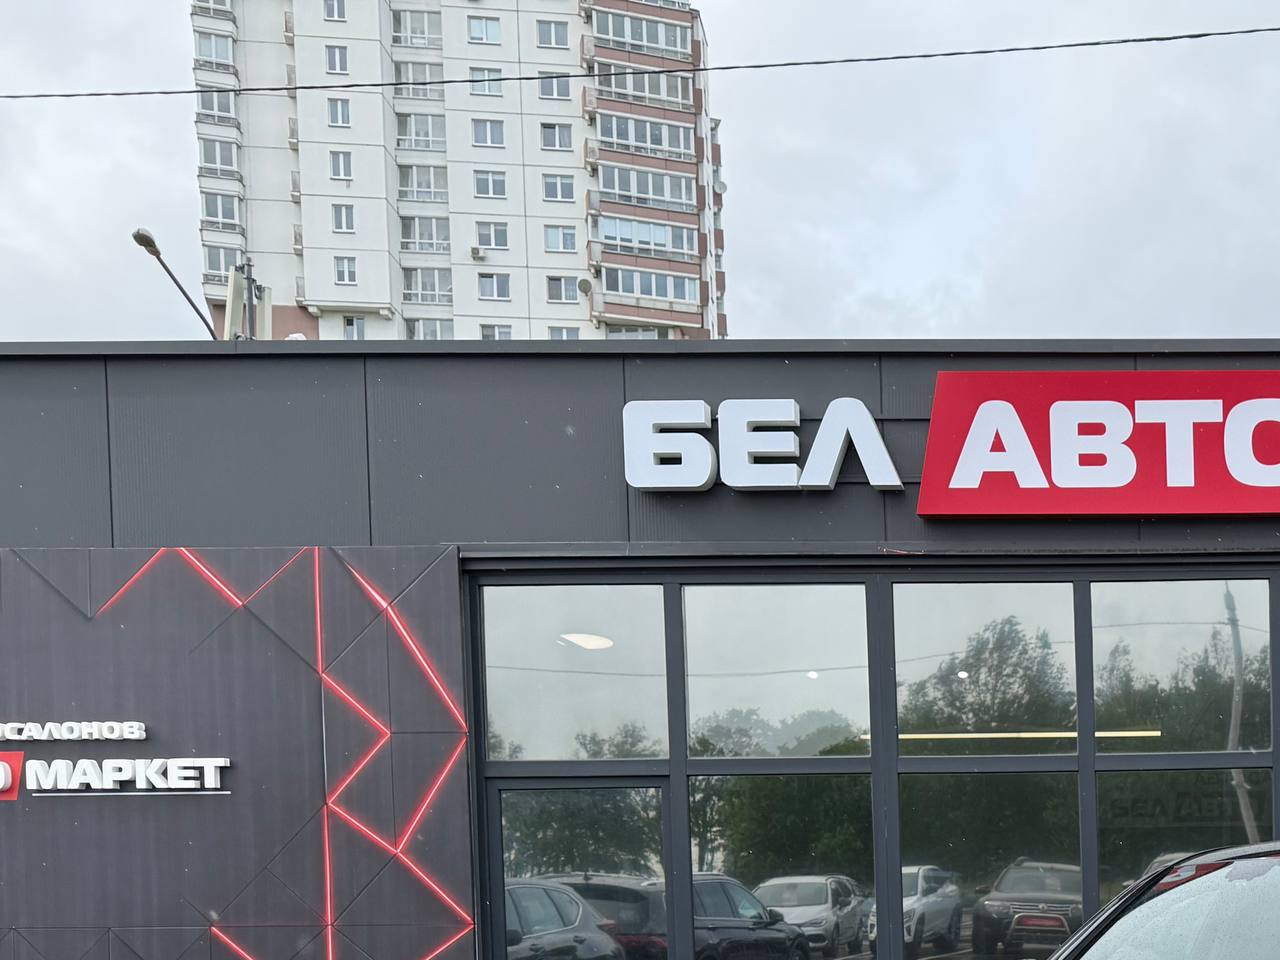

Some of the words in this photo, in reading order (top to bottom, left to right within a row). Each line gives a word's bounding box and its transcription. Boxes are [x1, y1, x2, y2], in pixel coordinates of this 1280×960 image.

[622, 397, 905, 492] БЕЛ
[0, 721, 147, 741] САЛОНОВ
[25, 757, 231, 790] МАРКЕТ
